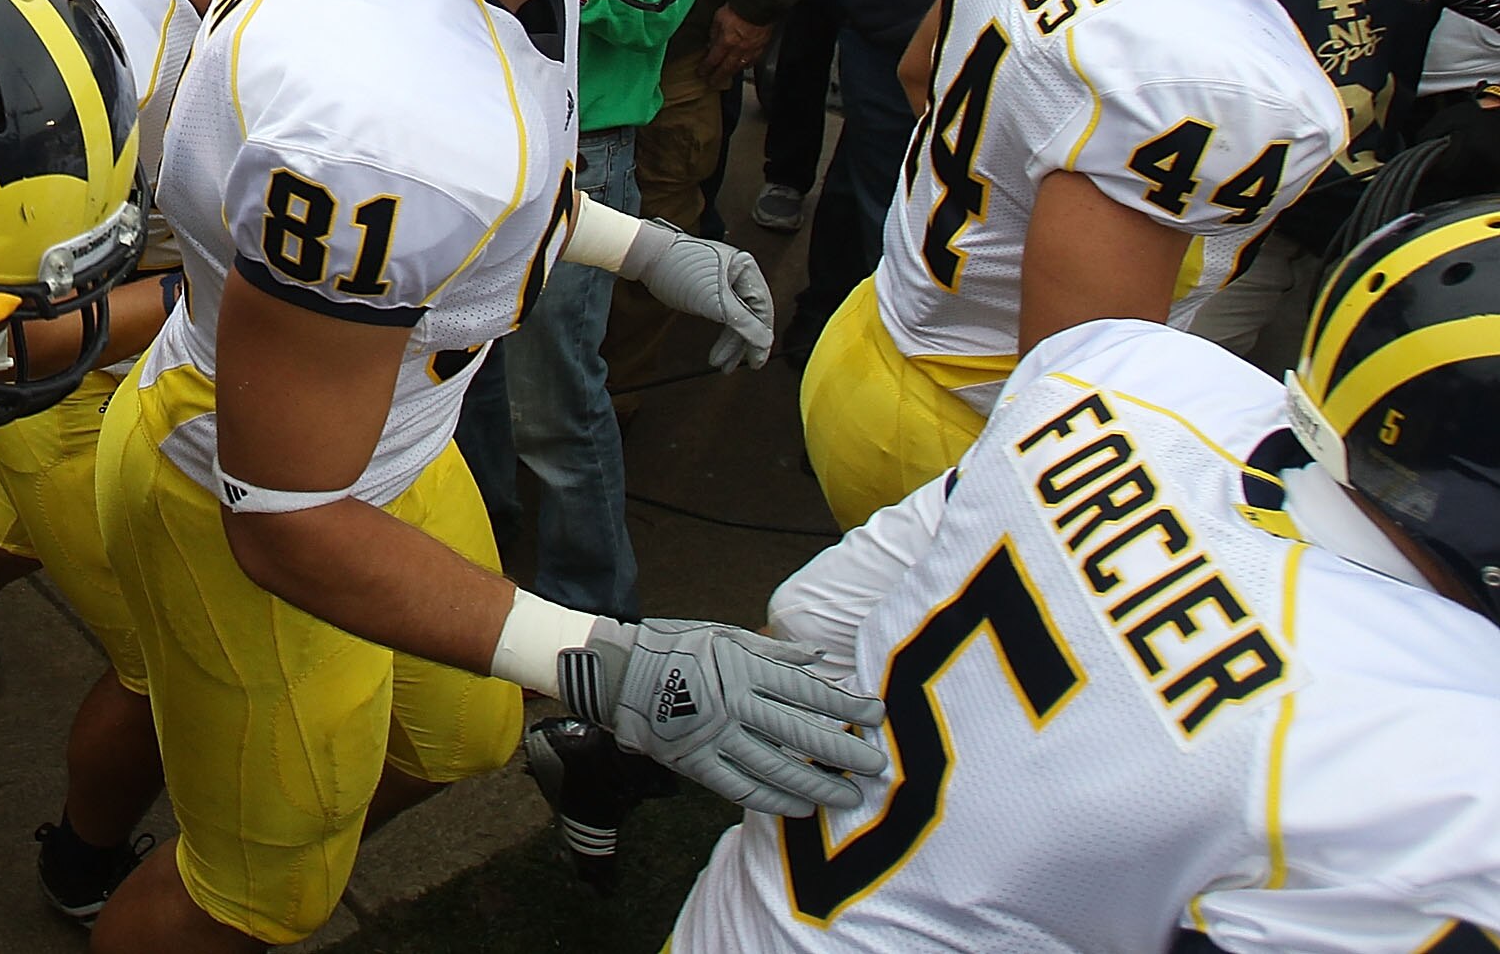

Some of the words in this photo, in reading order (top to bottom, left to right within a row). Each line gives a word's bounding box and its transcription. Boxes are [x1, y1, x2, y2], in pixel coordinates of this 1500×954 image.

[1124, 115, 1293, 226] 44
[261, 166, 403, 297] 81
[1378, 408, 1405, 445] 5
[1015, 390, 1291, 735] FORCIER
[656, 668, 681, 724] adidas
[778, 532, 1089, 930] 5
